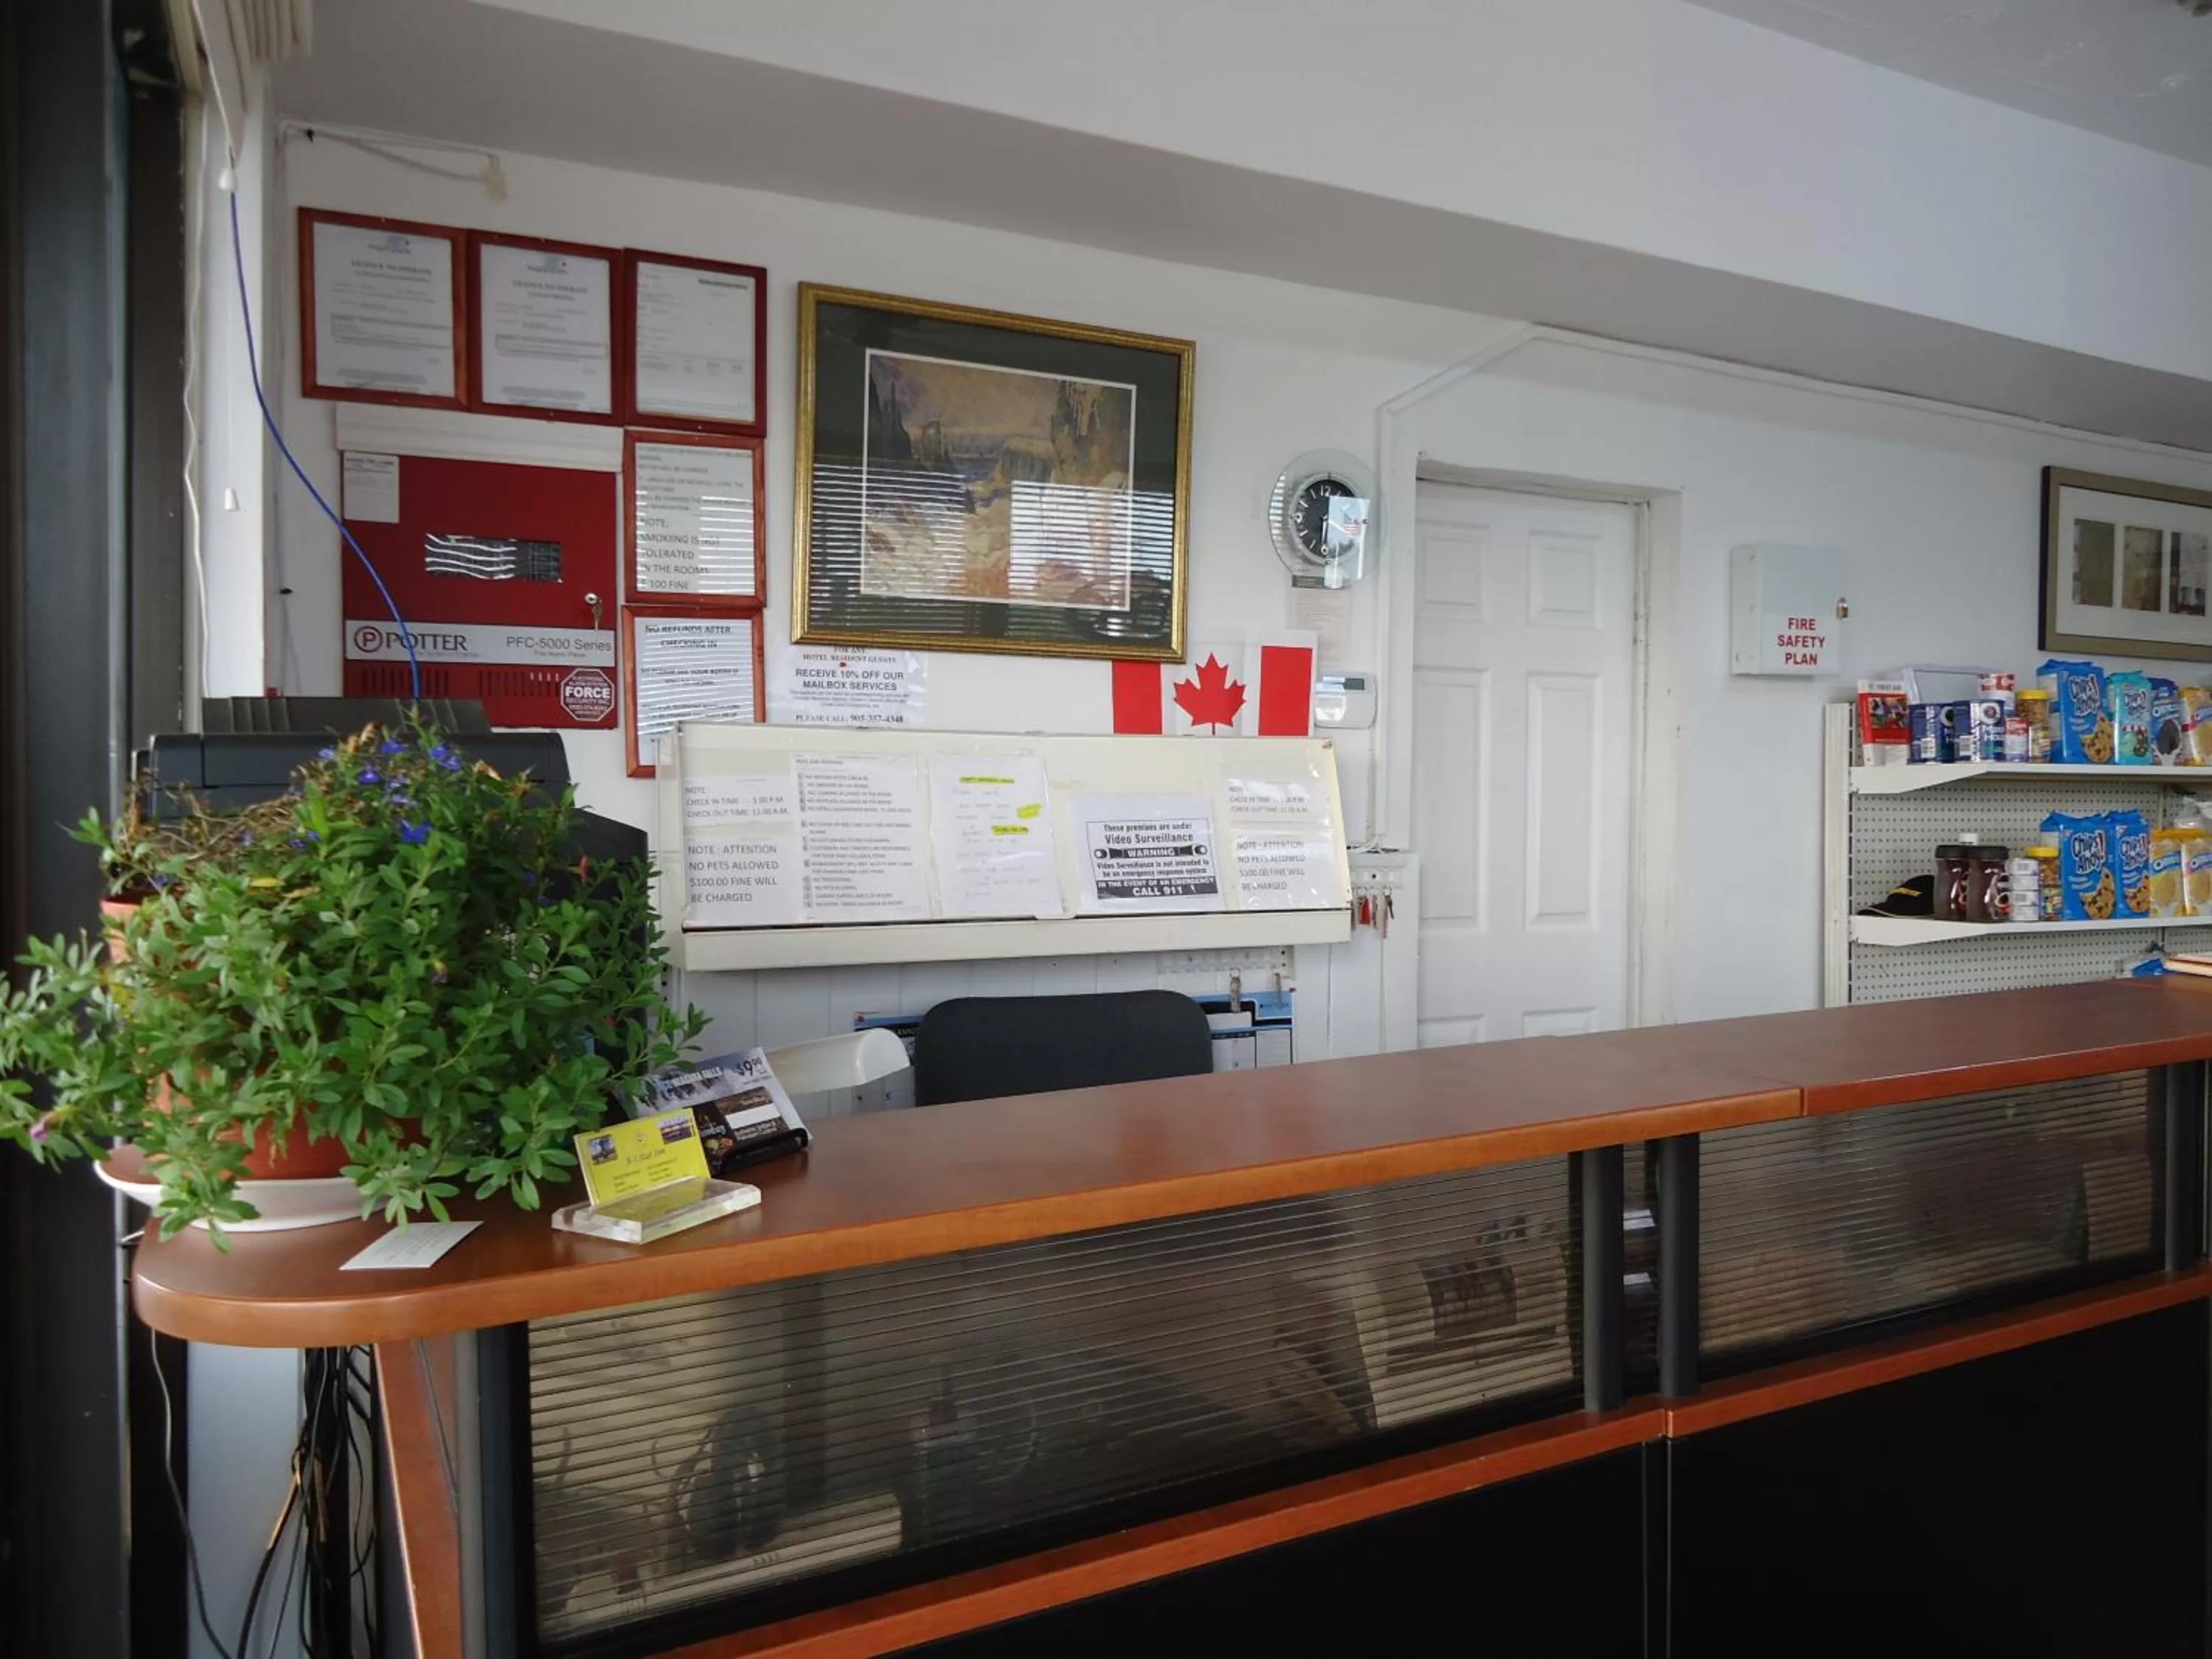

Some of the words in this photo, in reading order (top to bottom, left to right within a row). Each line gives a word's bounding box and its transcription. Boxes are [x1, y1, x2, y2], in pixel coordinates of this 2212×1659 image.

[653, 565, 672, 573] THE
[1788, 617, 1816, 630] FIRE
[386, 633, 468, 651] POTTER
[507, 636, 570, 650] PFC-5000
[574, 639, 612, 652] Series
[1778, 635, 1825, 648] SAFETY
[1785, 653, 1818, 665] PLAN
[796, 669, 837, 678] RECEIVE
[841, 670, 859, 678] 10%
[862, 670, 880, 679] OFF
[883, 672, 903, 680] OUR
[803, 681, 846, 689] MAILBOX
[849, 681, 897, 691] SERVICES
[566, 686, 611, 698] FORCE
[1103, 824, 1124, 832] These
[1126, 823, 1157, 832] premises
[1172, 821, 1192, 830] under
[1105, 834, 1132, 844] Video
[1135, 832, 1194, 844] Surveillance
[688, 844, 714, 855] NOTE
[723, 844, 777, 854] ATTENTION
[1127, 849, 1176, 858] WARNING
[1238, 855, 1250, 863] NO
[1252, 855, 1269, 863] PETS
[1270, 854, 1306, 863] ALLOWED
[689, 861, 704, 871] NO
[707, 860, 729, 870] PETS
[731, 860, 779, 870] ALLOWED
[1186, 868, 1207, 876] system
[731, 877, 751, 886] FINE
[754, 876, 777, 886] WILL
[1133, 886, 1161, 897] CALL
[1163, 886, 1183, 895] 911
[691, 893, 703, 903] BE
[705, 893, 753, 902] CHARGED
